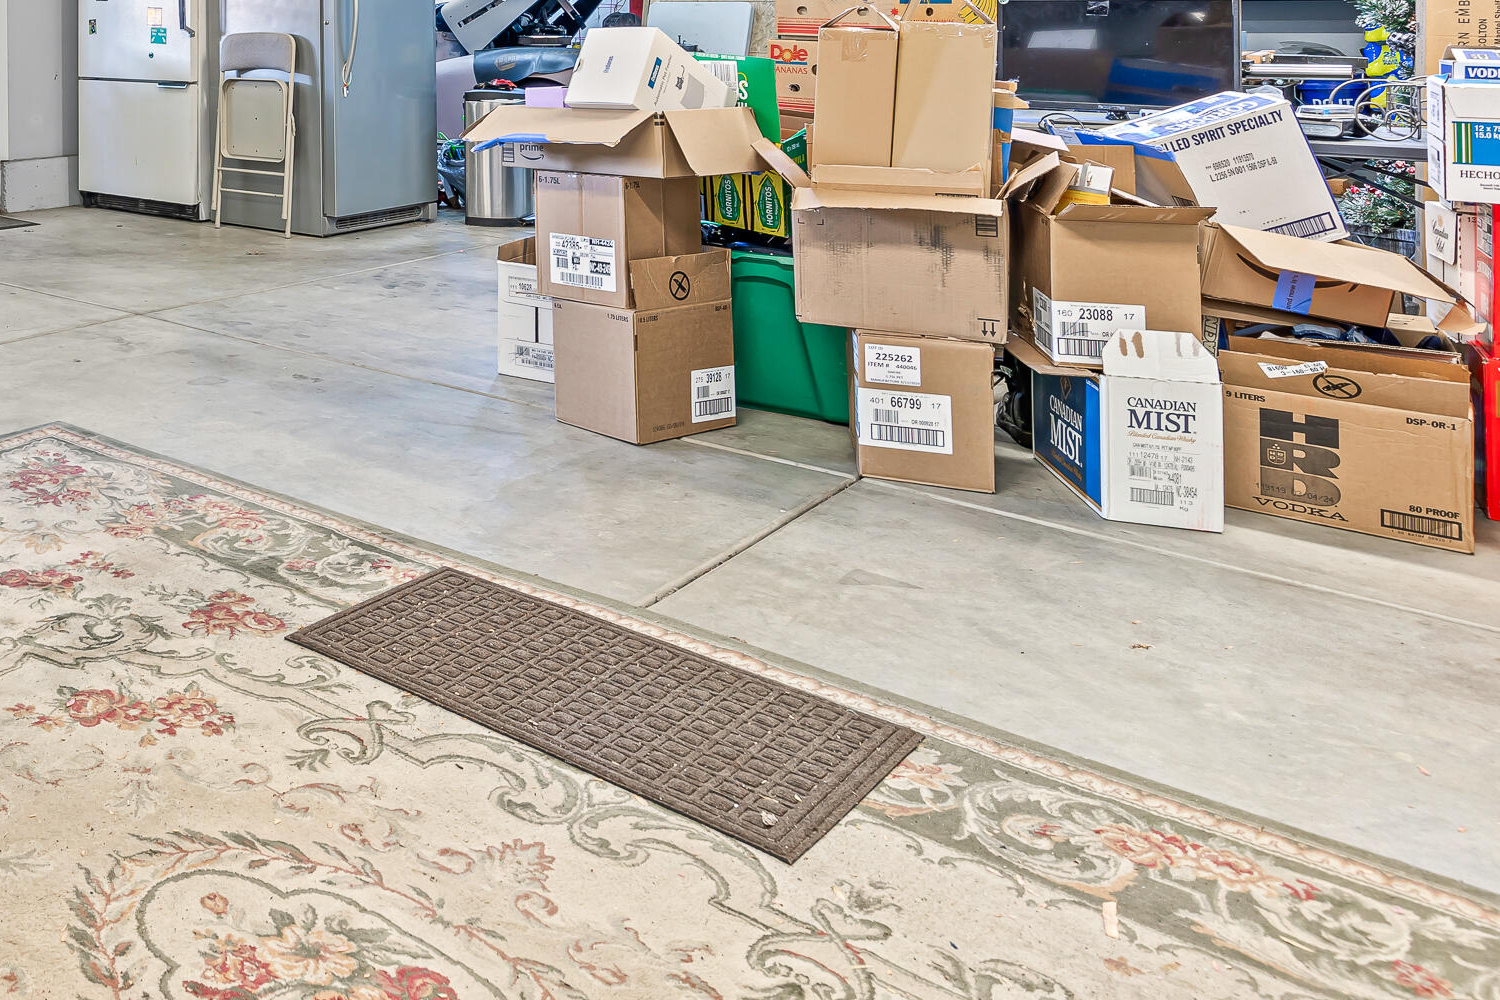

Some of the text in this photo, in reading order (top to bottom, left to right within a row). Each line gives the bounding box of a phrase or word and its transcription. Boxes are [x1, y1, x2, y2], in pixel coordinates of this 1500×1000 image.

[1478, 18, 1488, 46] OLTON
[770, 44, 808, 62] Dole
[775, 66, 808, 75] ANANAS
[1191, 126, 1227, 146] SPIRIT
[1226, 109, 1284, 135] SPECIALTY
[519, 144, 544, 152] prime
[1460, 169, 1500, 180] HECHO
[724, 179, 733, 218] HORNITOS
[764, 186, 774, 226] HORNITOS
[616, 314, 629, 323] LITERS
[1078, 307, 1113, 321] 23088
[1203, 315, 1219, 357] ACIN
[875, 352, 913, 363] 225262
[869, 396, 941, 410] 401 66799 17
[1126, 396, 1197, 413] CANADIAN
[1234, 391, 1266, 403] LITERS
[1050, 394, 1083, 433] CANADIAN
[1126, 408, 1197, 434] MIST
[1405, 417, 1457, 431] DSP-OR-1
[1050, 412, 1083, 468] MIST
[1151, 432, 1177, 441] Canadian
[1252, 496, 1348, 522] VODKA
[1408, 504, 1461, 520] 80 PROOF
